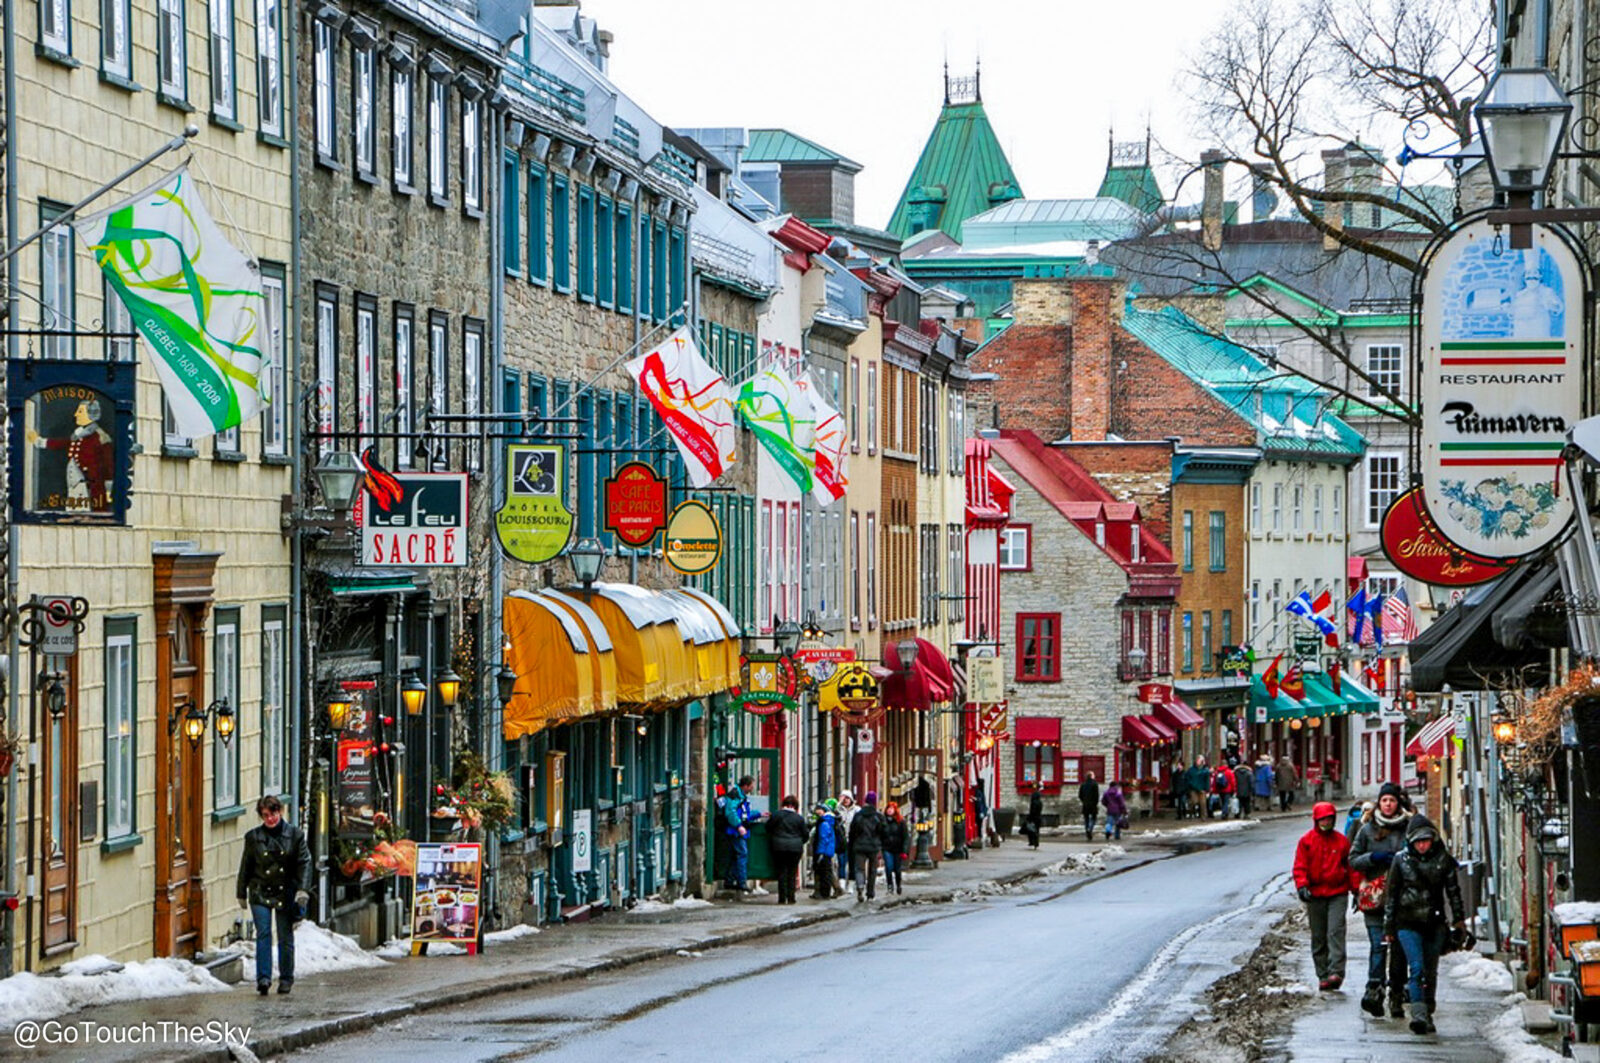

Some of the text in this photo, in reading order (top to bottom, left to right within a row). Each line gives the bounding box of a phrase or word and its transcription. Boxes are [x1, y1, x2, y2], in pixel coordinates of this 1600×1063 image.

[144, 319, 180, 356] QUÉBEC
[1440, 374, 1565, 385] RESTAURANT
[1440, 402, 1566, 434] Primavera
[509, 503, 559, 512] HÔTEL
[610, 501, 661, 514] DE PARIS
[375, 514, 406, 526] LE
[499, 513, 570, 526] LOUISBOURG
[373, 528, 457, 563] SACRÉ
